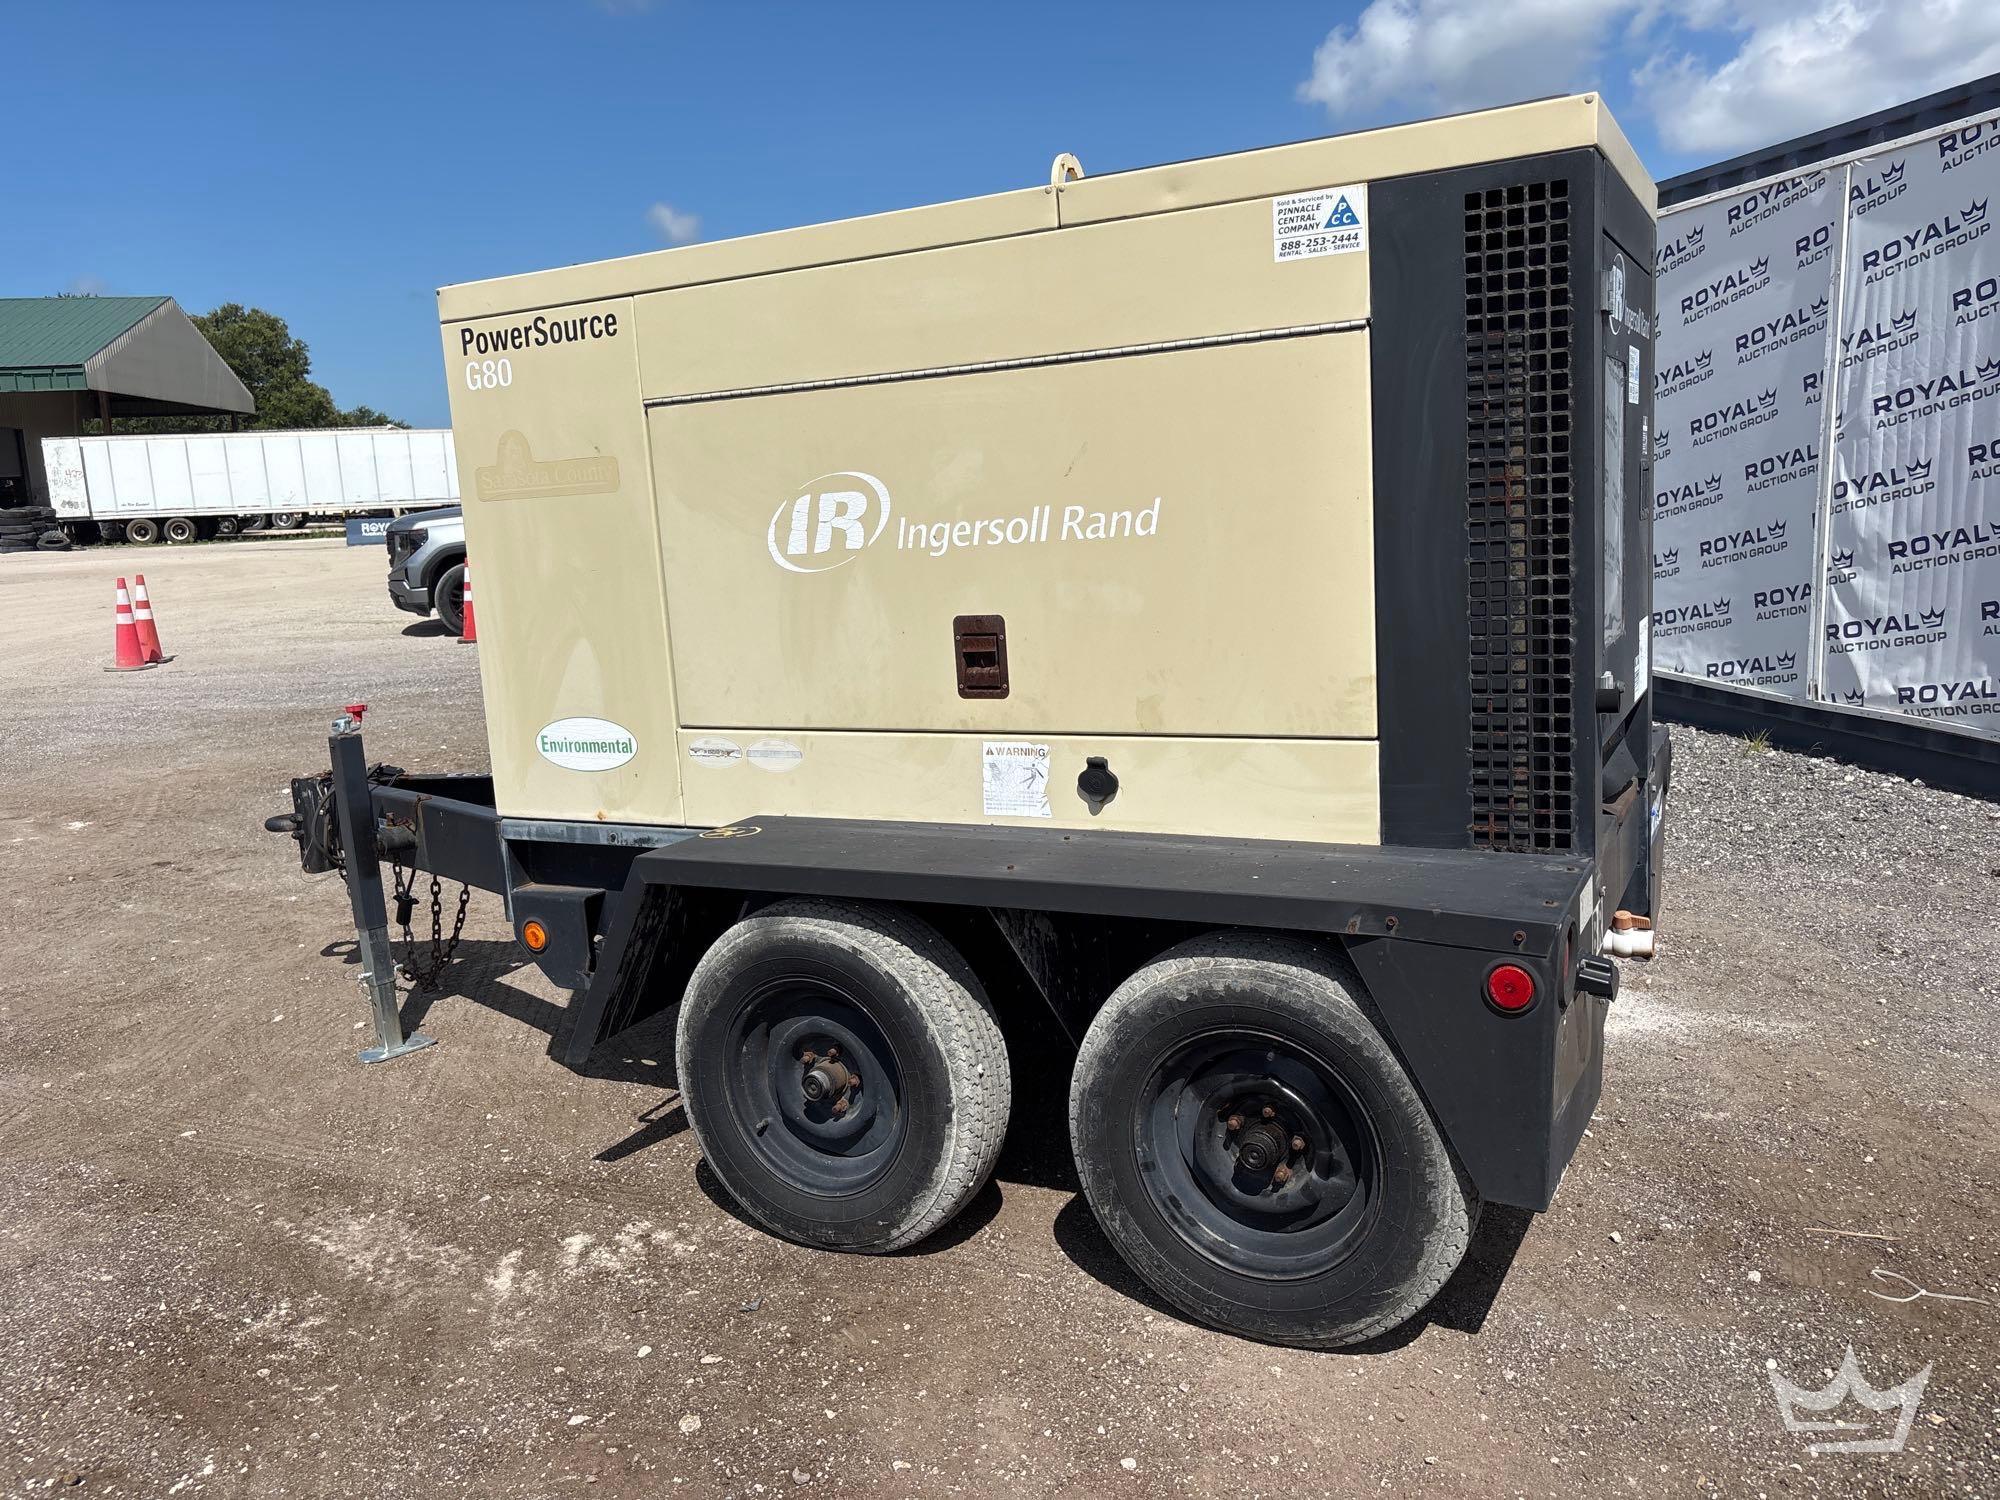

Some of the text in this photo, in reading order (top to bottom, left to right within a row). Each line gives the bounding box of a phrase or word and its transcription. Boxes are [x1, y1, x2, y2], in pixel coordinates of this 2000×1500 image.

[1278, 203, 1321, 216] PINNACLE
[1298, 194, 1324, 204] Serviced
[1338, 202, 1347, 213] P
[1728, 176, 1803, 225] ROYAL
[1730, 203, 1781, 238] AUCTION
[1783, 177, 1826, 208] GROUP
[1857, 183, 1907, 216] GROUP
[1278, 213, 1316, 226] CENTRAL
[1278, 222, 1321, 235] COMPANY
[1279, 250, 1302, 258] RENTAL
[1308, 246, 1327, 254] SALES
[1333, 242, 1360, 251] SERVICE
[1280, 232, 1359, 251] 888-253-2444
[1863, 216, 1961, 272] ROYAL
[1865, 222, 1991, 286] AUCTION GROUP
[1670, 244, 1706, 270] GROUP
[1681, 270, 1750, 314] ROYAL
[1683, 296, 1729, 327] AUCTION
[1731, 276, 1770, 303] GROUP
[461, 312, 618, 356] PowerSource
[1736, 308, 1811, 352] ROYAL
[1737, 336, 1788, 366] AUCTION
[1866, 332, 1919, 359] GROUP
[465, 358, 513, 391] G80
[1679, 369, 1714, 391] GROUP
[1873, 370, 1976, 416] ROYAL
[1690, 399, 1758, 435] ROYAL
[1692, 409, 1779, 448] AUCTION GROUP
[1876, 401, 1946, 431] AUCTION
[1745, 445, 1819, 480] ROYAL
[1747, 471, 1797, 494] AUCTION
[1833, 468, 1906, 500] OYAL
[1880, 481, 1935, 503] GROUP
[1688, 493, 1724, 511] GROUP
[787, 491, 868, 555] IR
[897, 497, 1162, 557] Ingersoll Rand
[1700, 527, 1768, 557] ROYAL
[1701, 541, 1788, 569] AUCTION GROUP
[1888, 524, 1990, 560] ROYAL
[1892, 544, 2000, 574] AUCTION GRO
[1828, 572, 1857, 585] OUP
[1652, 603, 1714, 627] ROYAL
[1756, 605, 1807, 621] AUCTION
[1653, 617, 1732, 638] AUCTION GROUP
[1826, 614, 1919, 641] ROYAL
[1828, 632, 1947, 655] AUCTION GROUP
[1706, 656, 1777, 678] ROYAL
[1757, 673, 1798, 686] GROUP
[1898, 679, 1997, 705] ROYAL
[540, 735, 633, 754] Environmental
[995, 746, 1046, 757] WARNING
